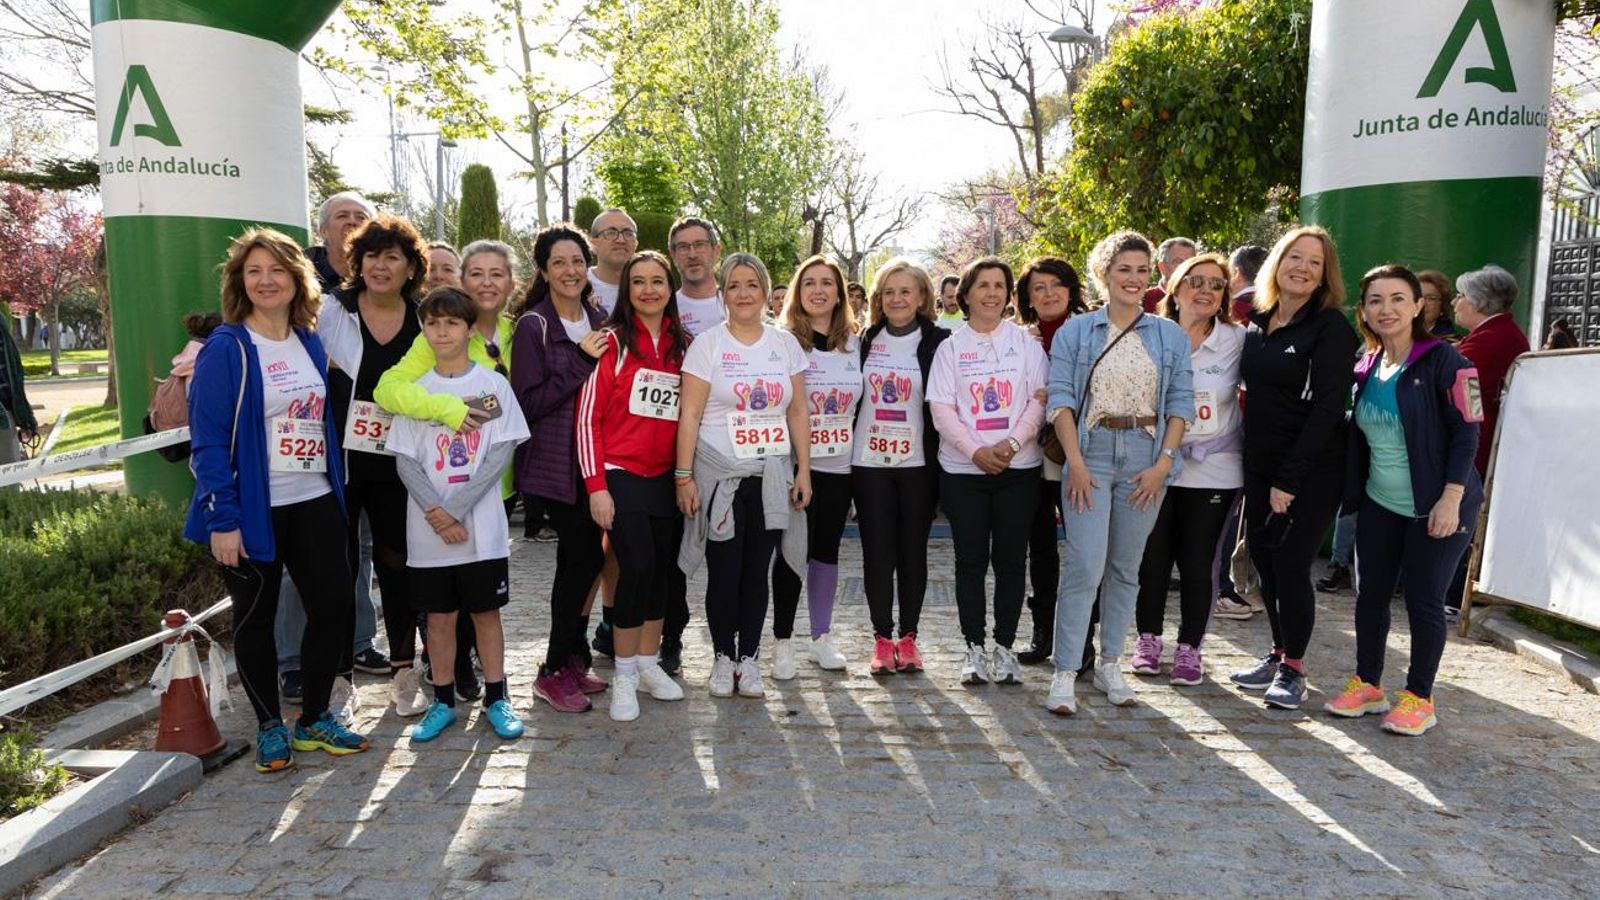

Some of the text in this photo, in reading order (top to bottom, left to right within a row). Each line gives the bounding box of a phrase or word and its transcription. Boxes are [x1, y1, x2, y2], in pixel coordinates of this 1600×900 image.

[1352, 113, 1420, 138] Junta
[1427, 108, 1459, 130] de
[116, 156, 134, 173] de
[138, 156, 241, 178] Andalucía
[638, 385, 681, 408] 1027
[352, 418, 392, 438] 53
[735, 427, 785, 445] 5812
[810, 428, 850, 446] 5815
[279, 437, 325, 457] 5224
[868, 436, 911, 455] 5813
